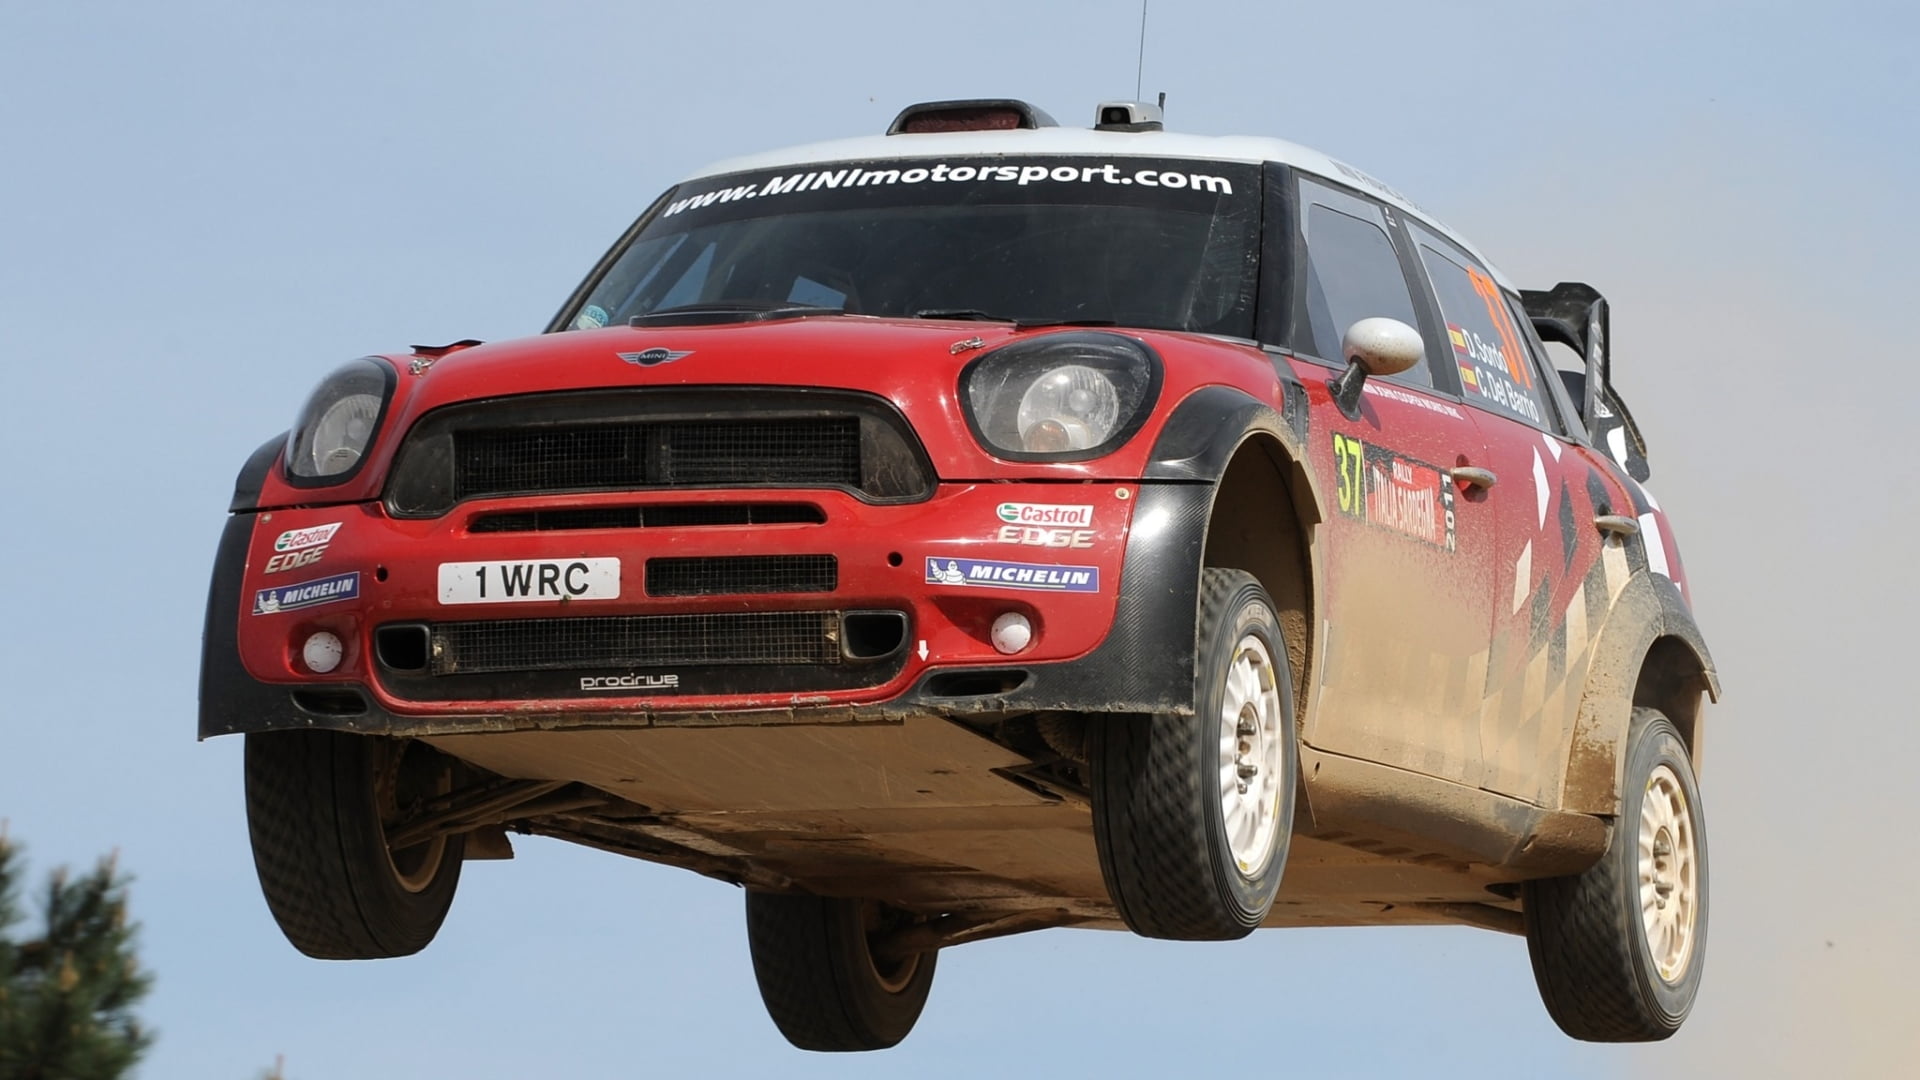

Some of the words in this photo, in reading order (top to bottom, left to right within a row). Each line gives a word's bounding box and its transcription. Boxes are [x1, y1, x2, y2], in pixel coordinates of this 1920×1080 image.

[663, 163, 1233, 218] www.MINImotorsport.com
[640, 352, 667, 360] MINI
[1334, 433, 1361, 517] 37
[1392, 461, 1413, 485] RALLY
[1020, 505, 1086, 525] Castrol
[1442, 473, 1456, 553] 2011
[289, 525, 336, 547] Castrol
[997, 525, 1096, 549] EDGE
[263, 544, 330, 575] EDGE
[475, 565, 487, 598] 1
[501, 562, 590, 597] WRC
[969, 564, 1091, 586] MICHELIN
[282, 578, 354, 604] MICHELIN
[580, 672, 680, 691] prodrive
